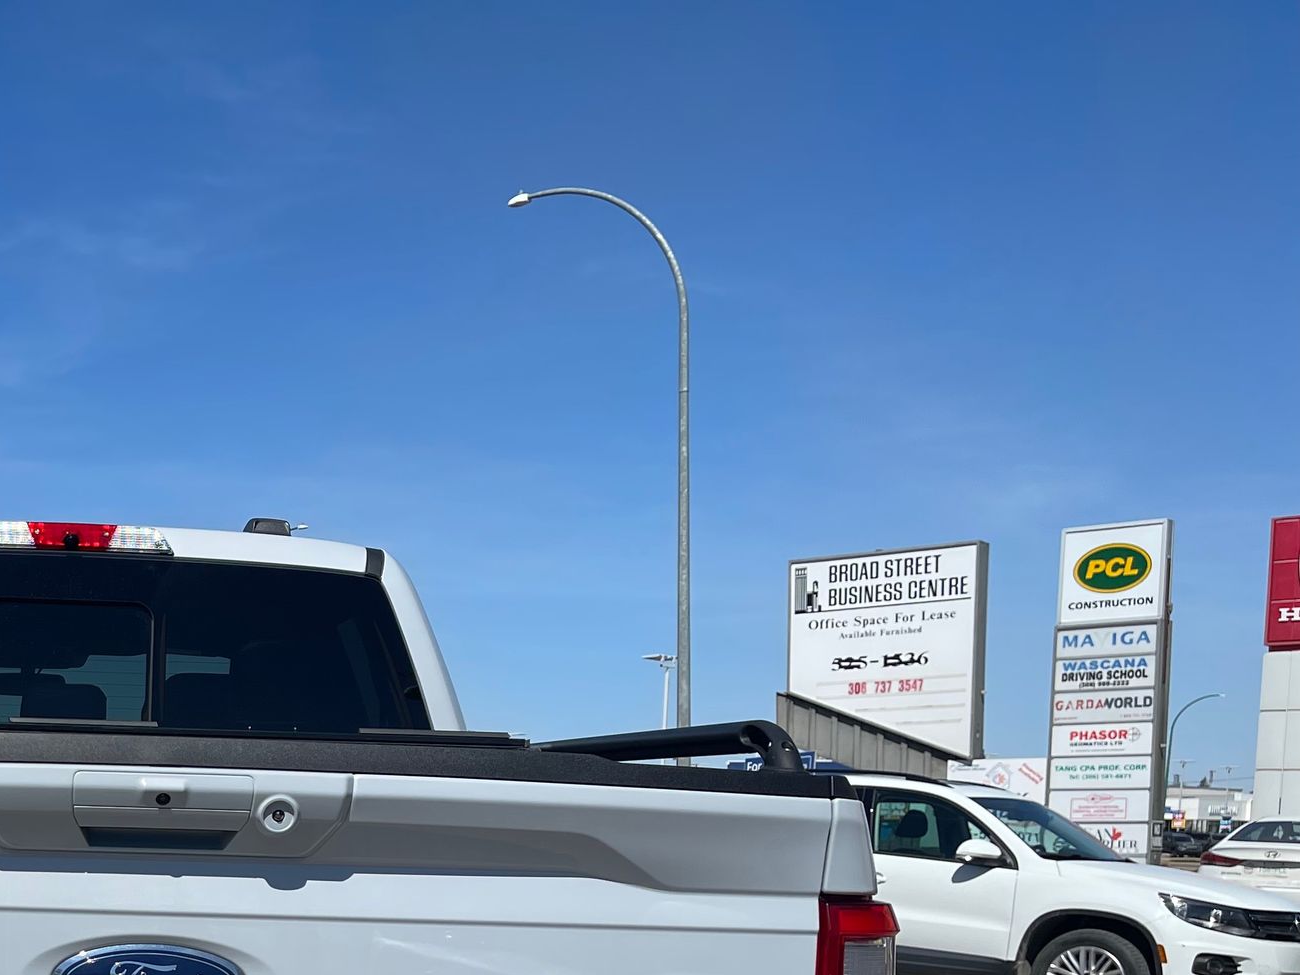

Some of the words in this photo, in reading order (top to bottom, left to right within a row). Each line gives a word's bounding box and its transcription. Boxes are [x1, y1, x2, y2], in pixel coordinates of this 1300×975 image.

[829, 561, 879, 583] BROAD
[884, 555, 942, 578] STREET
[1085, 556, 1139, 580] PCL
[828, 582, 903, 606] BUSINESS
[908, 576, 968, 600] CENTRE
[1068, 597, 1154, 610] CONSTRUCTION
[808, 618, 849, 630] Office
[853, 615, 889, 628] Space
[894, 612, 915, 623] For
[921, 610, 957, 621] Lease
[839, 630, 876, 640] Available
[880, 626, 922, 637] Furnished
[1062, 658, 1148, 672] WASCANA
[1061, 671, 1103, 682] DRIVING
[1106, 669, 1148, 680] SCHOOL
[874, 680, 892, 694] 737
[898, 679, 924, 692] 3547
[1069, 729, 1128, 741] PHASOR
